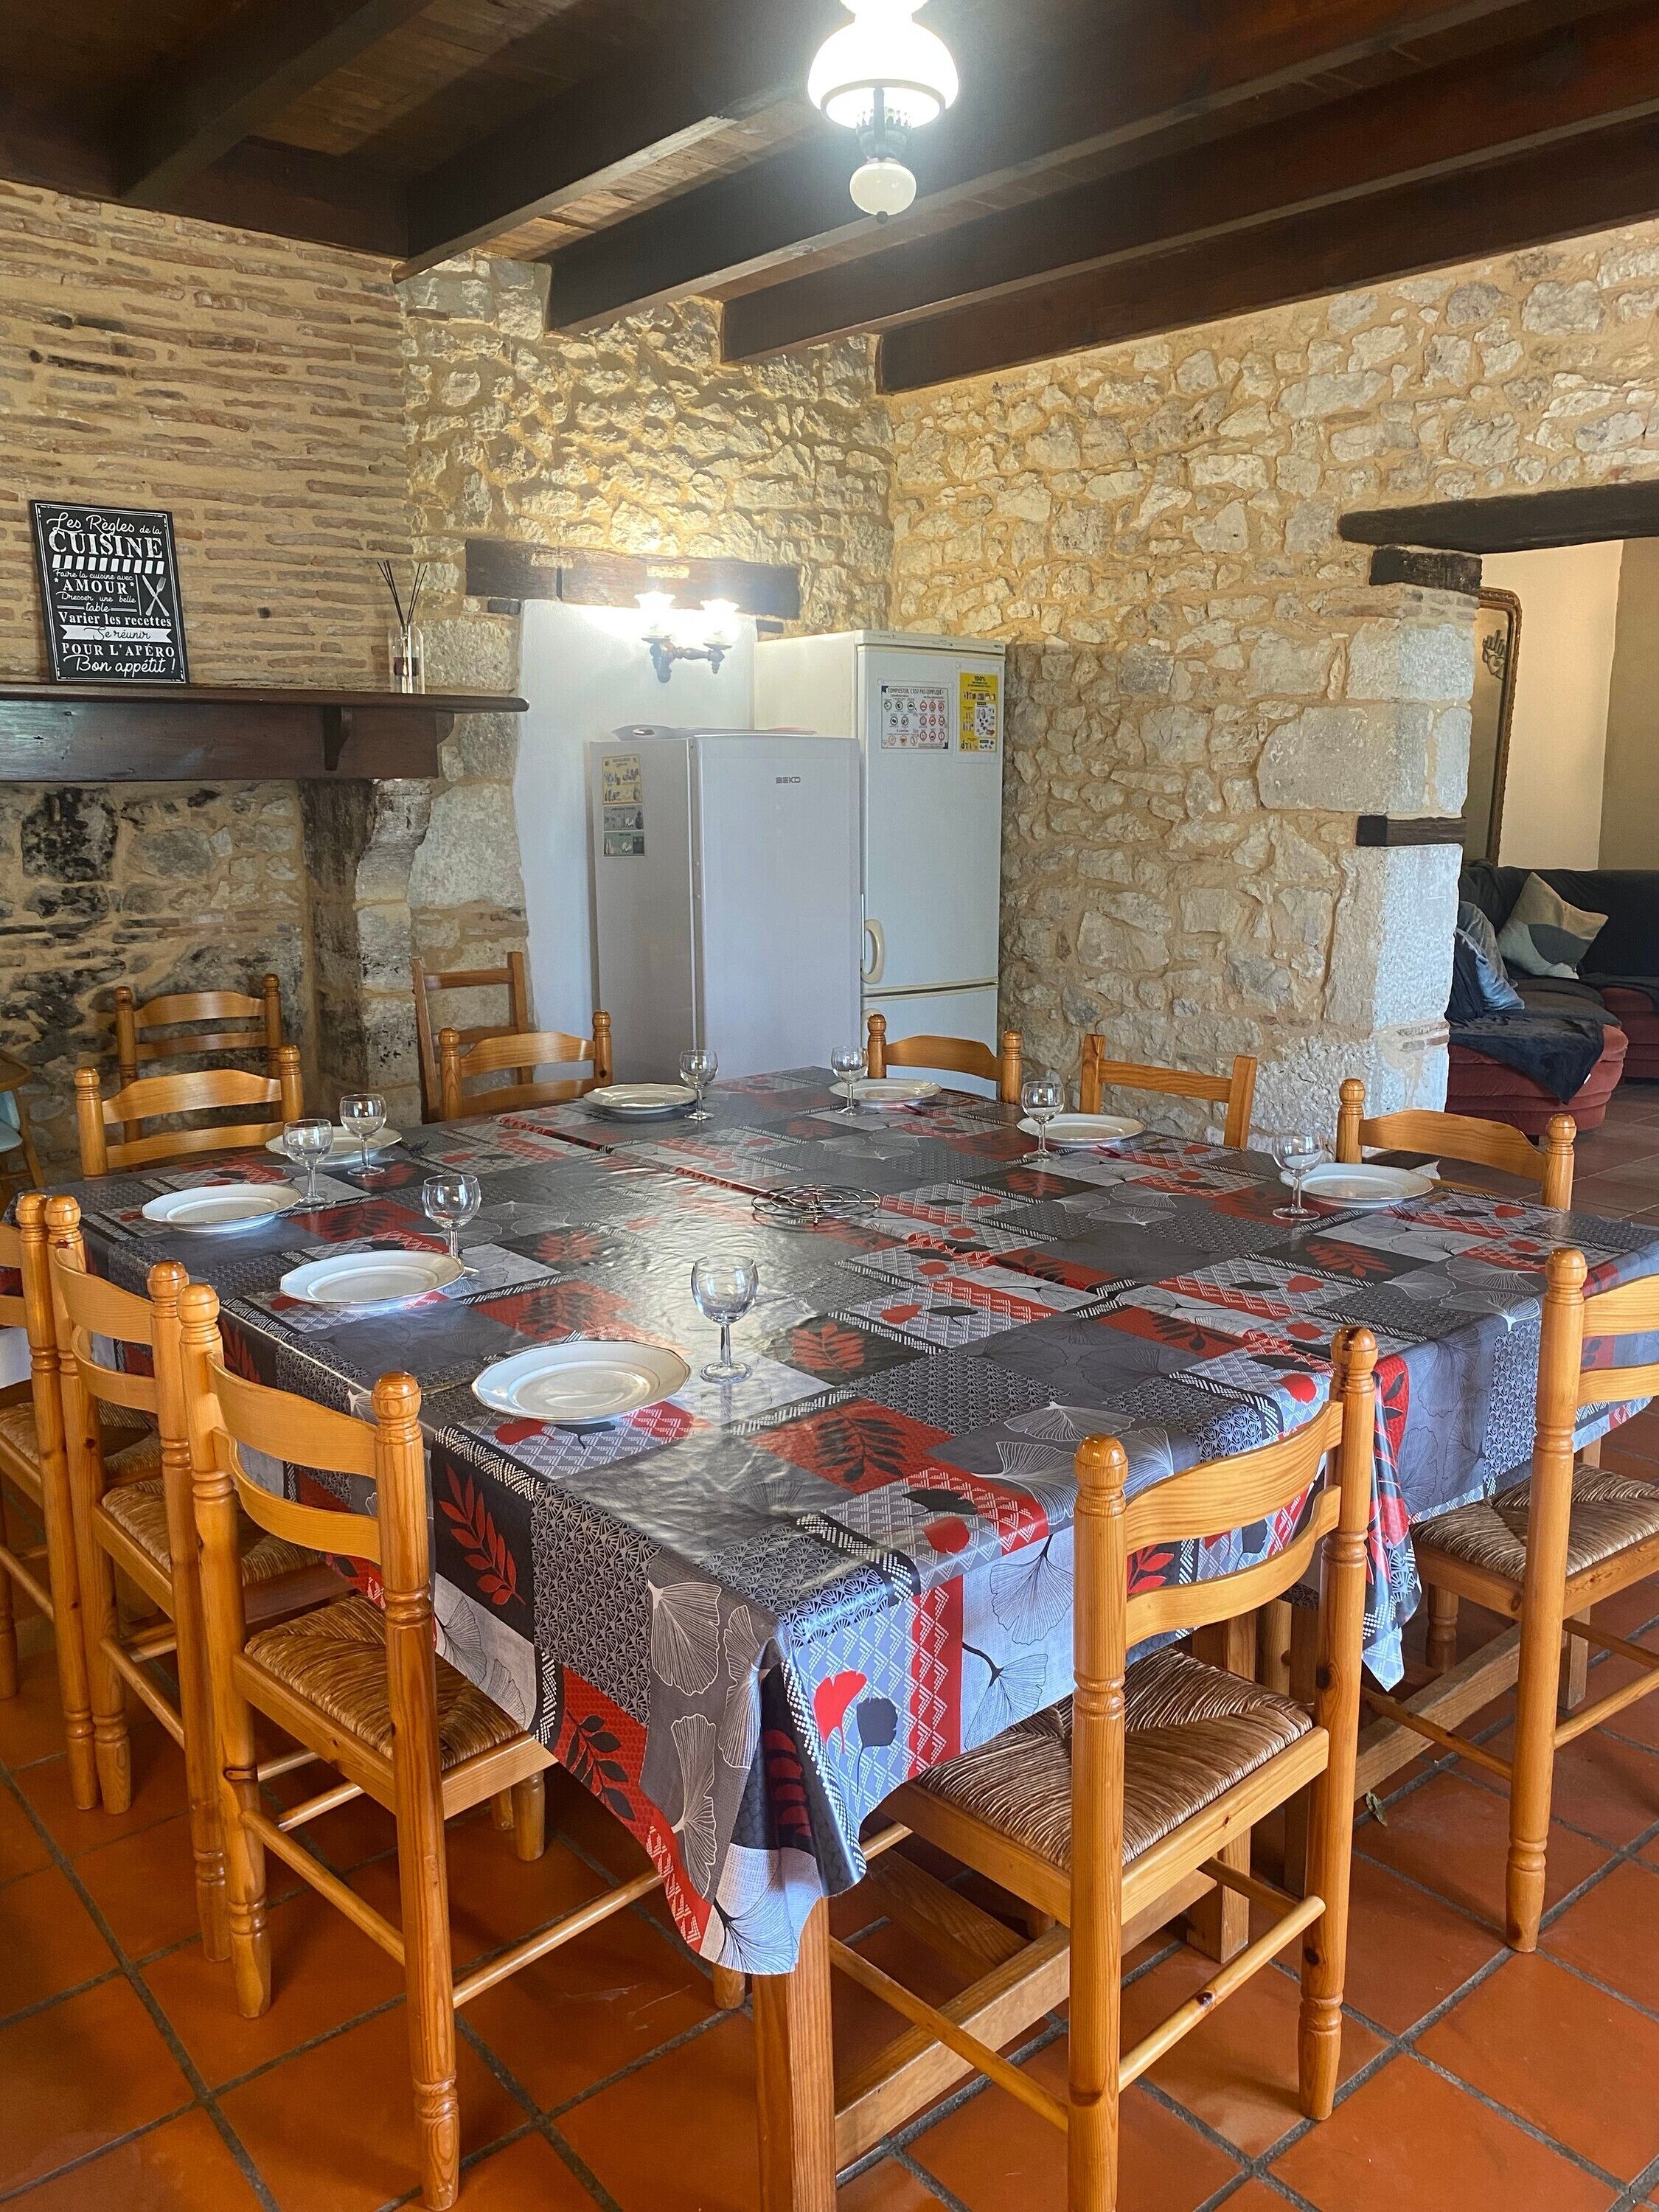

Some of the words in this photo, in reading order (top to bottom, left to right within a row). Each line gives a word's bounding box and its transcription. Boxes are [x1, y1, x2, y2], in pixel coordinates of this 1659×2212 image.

[46, 511, 83, 534] Les
[86, 515, 135, 536] Règles
[139, 524, 151, 534] de
[152, 524, 162, 535] la
[48, 529, 163, 559] CUISINE
[52, 568, 78, 579] Faire
[79, 569, 88, 579] la
[88, 572, 116, 580] cuisine
[63, 578, 128, 595] AMOUR
[55, 591, 94, 602] Dresser
[99, 595, 114, 603] une
[119, 594, 136, 604] belle
[86, 602, 110, 613] table
[58, 611, 100, 625] Varier
[105, 613, 122, 625] les
[125, 616, 172, 627] recettes
[83, 626, 112, 641] Se
[113, 629, 151, 639] réunir
[61, 642, 104, 656] POUR
[110, 643, 175, 658] L'APÉRO
[63, 654, 112, 672] Bon
[116, 657, 166, 678] appétit
